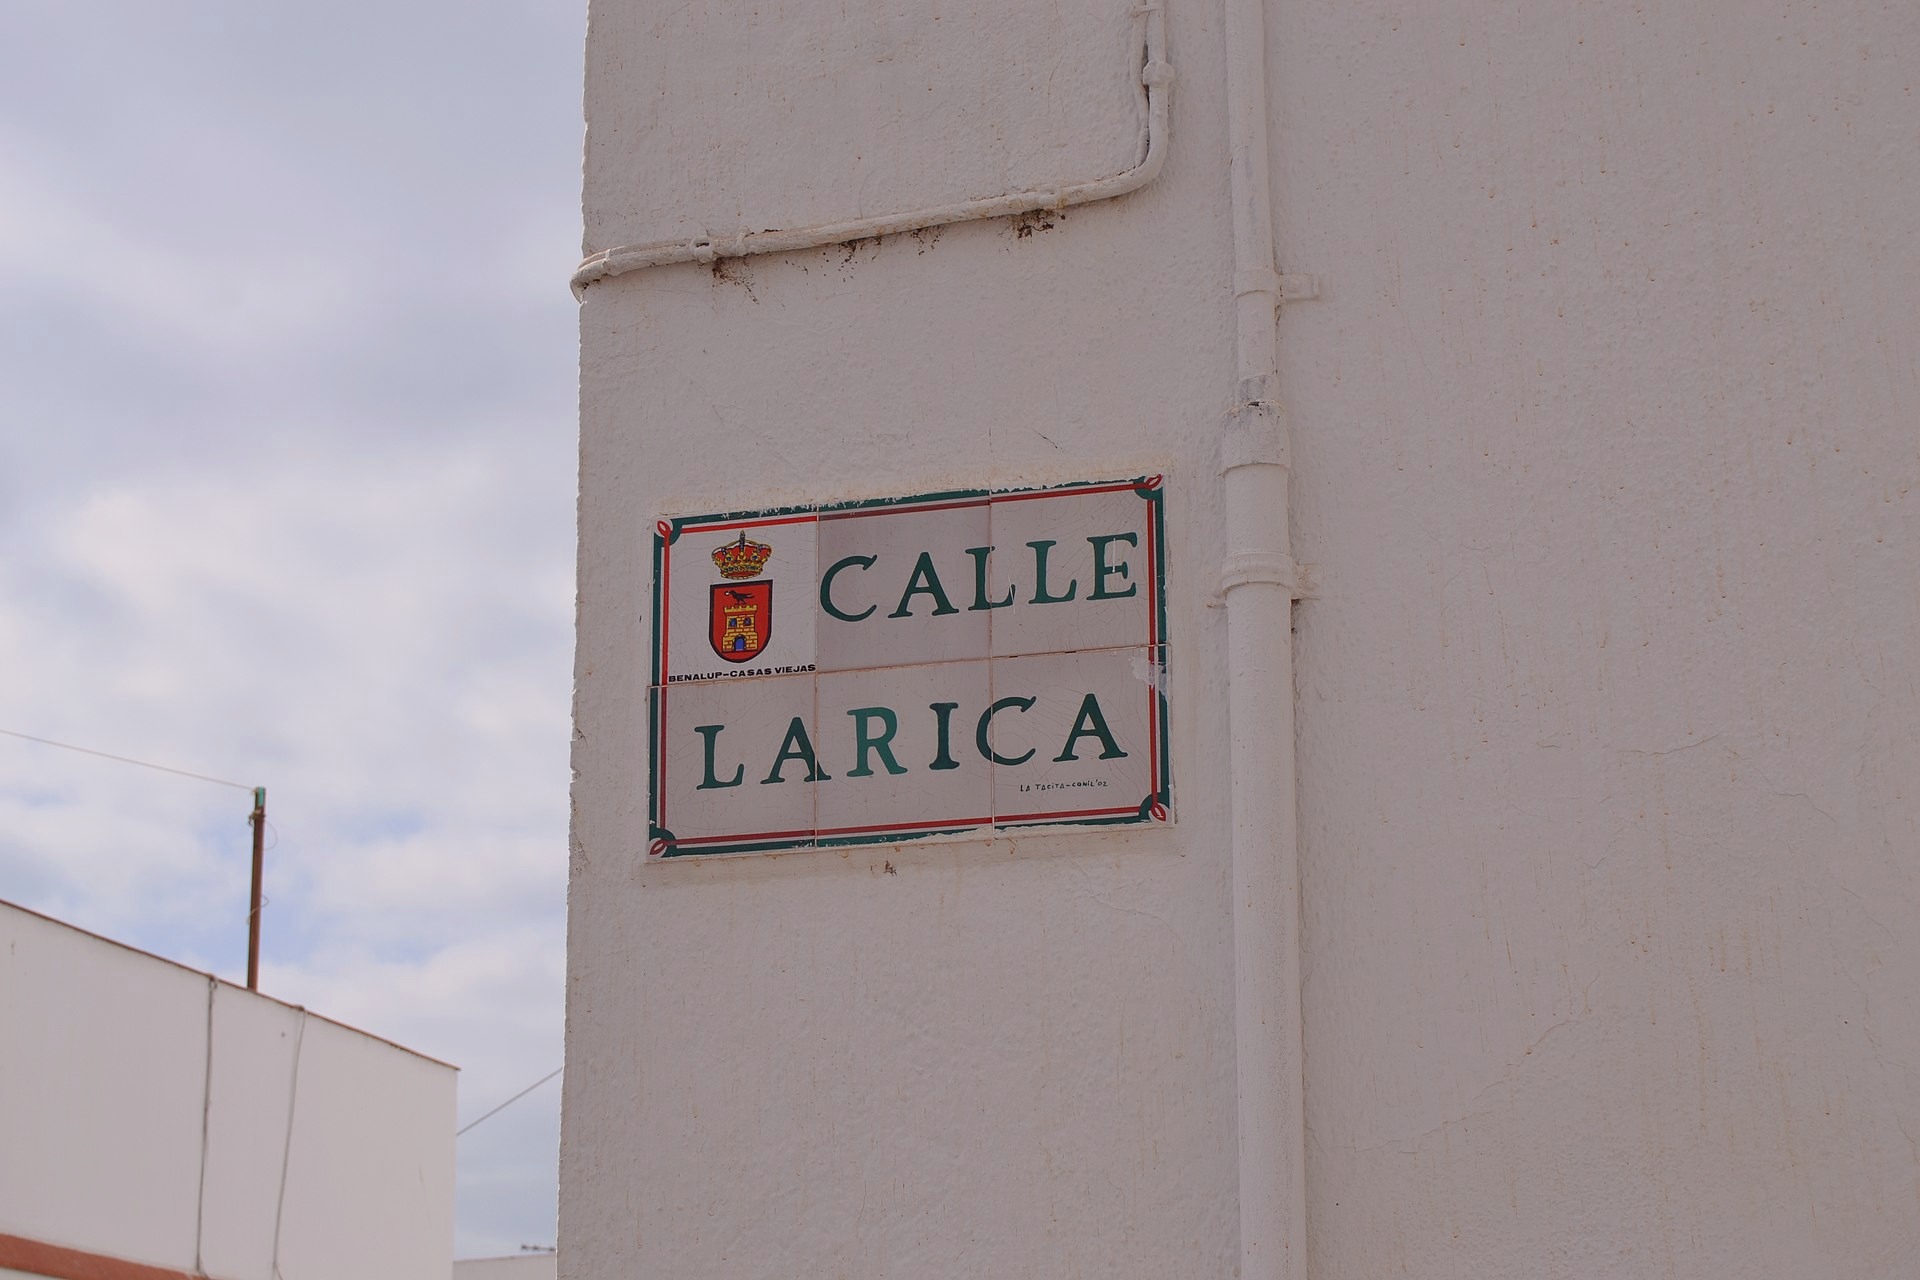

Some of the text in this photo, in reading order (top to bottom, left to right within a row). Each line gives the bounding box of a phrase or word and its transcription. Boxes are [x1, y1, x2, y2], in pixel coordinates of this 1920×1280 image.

[819, 531, 1138, 623] CALLE
[668, 663, 817, 682] BENALUP-CASAS VIEJAS
[1020, 783, 1031, 792] LA
